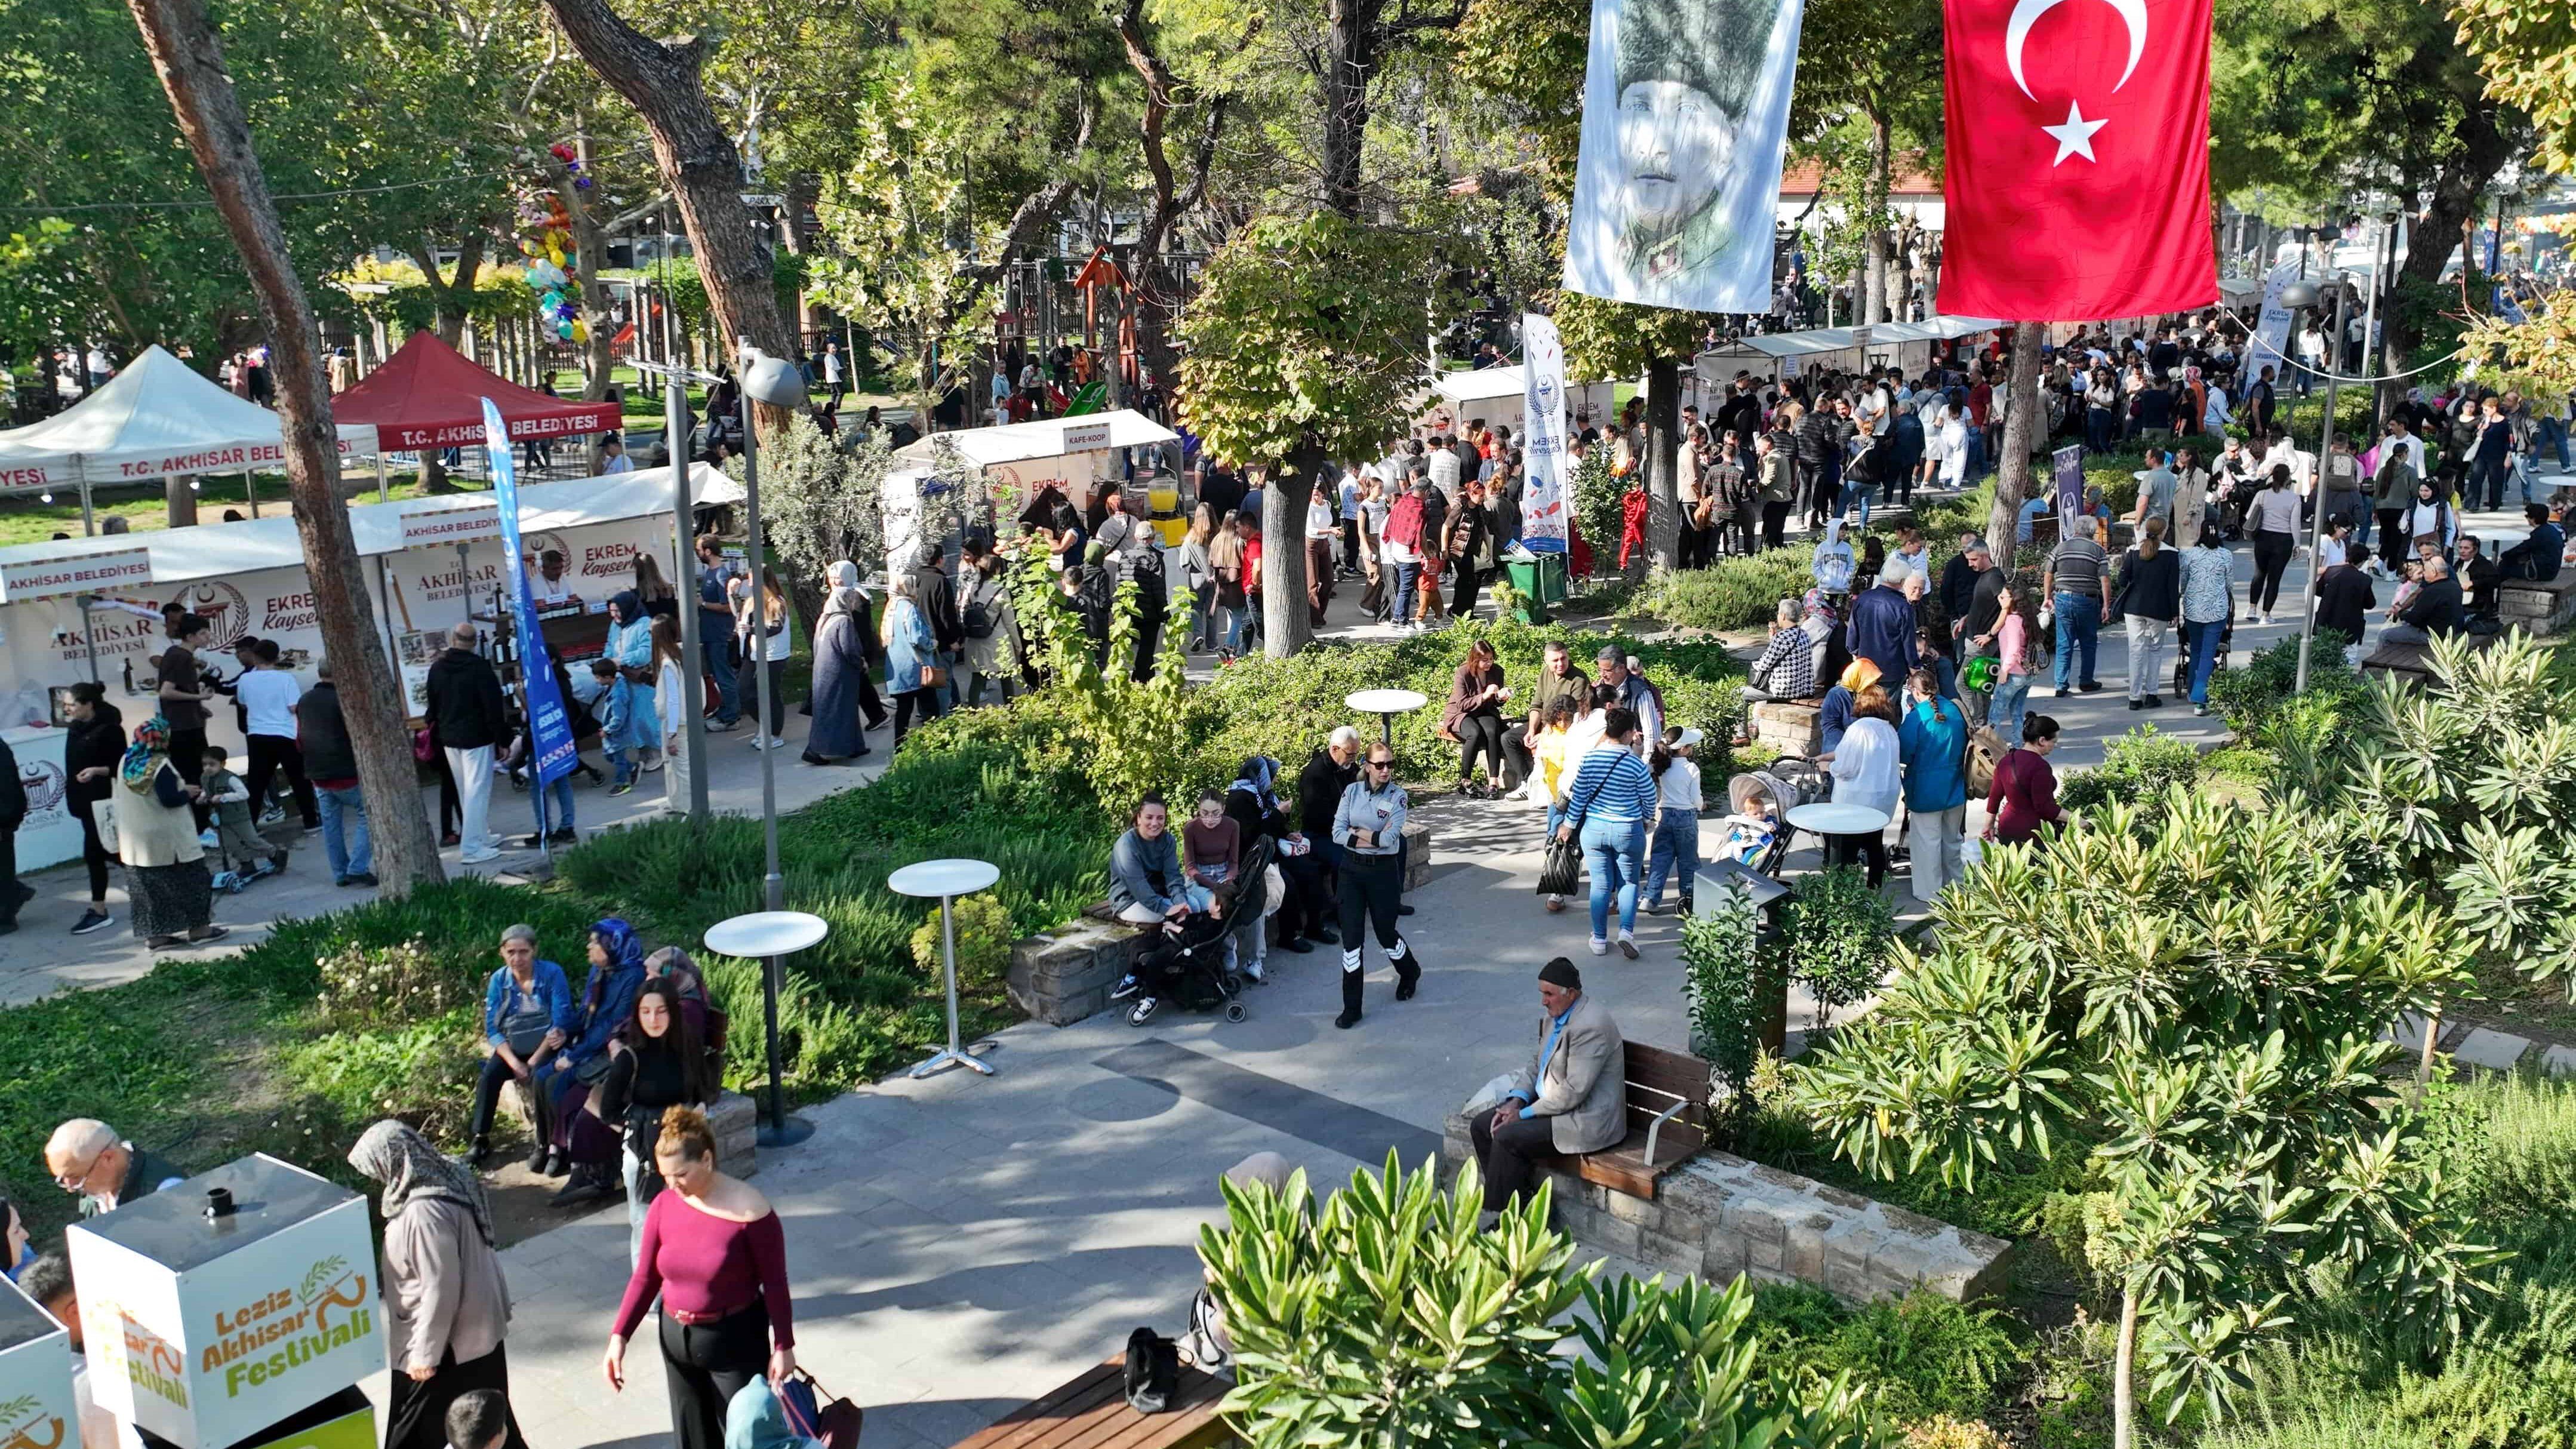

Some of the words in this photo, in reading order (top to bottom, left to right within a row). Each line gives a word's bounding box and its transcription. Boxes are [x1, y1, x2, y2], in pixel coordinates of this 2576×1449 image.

[1069, 433, 1106, 445] KAFE-KOOP
[586, 542, 637, 562] EKREM
[267, 593, 316, 613] EKRE
[216, 1287, 293, 1337] Leziz
[202, 1308, 310, 1374] Akhisar
[225, 1308, 372, 1398] Festivali
